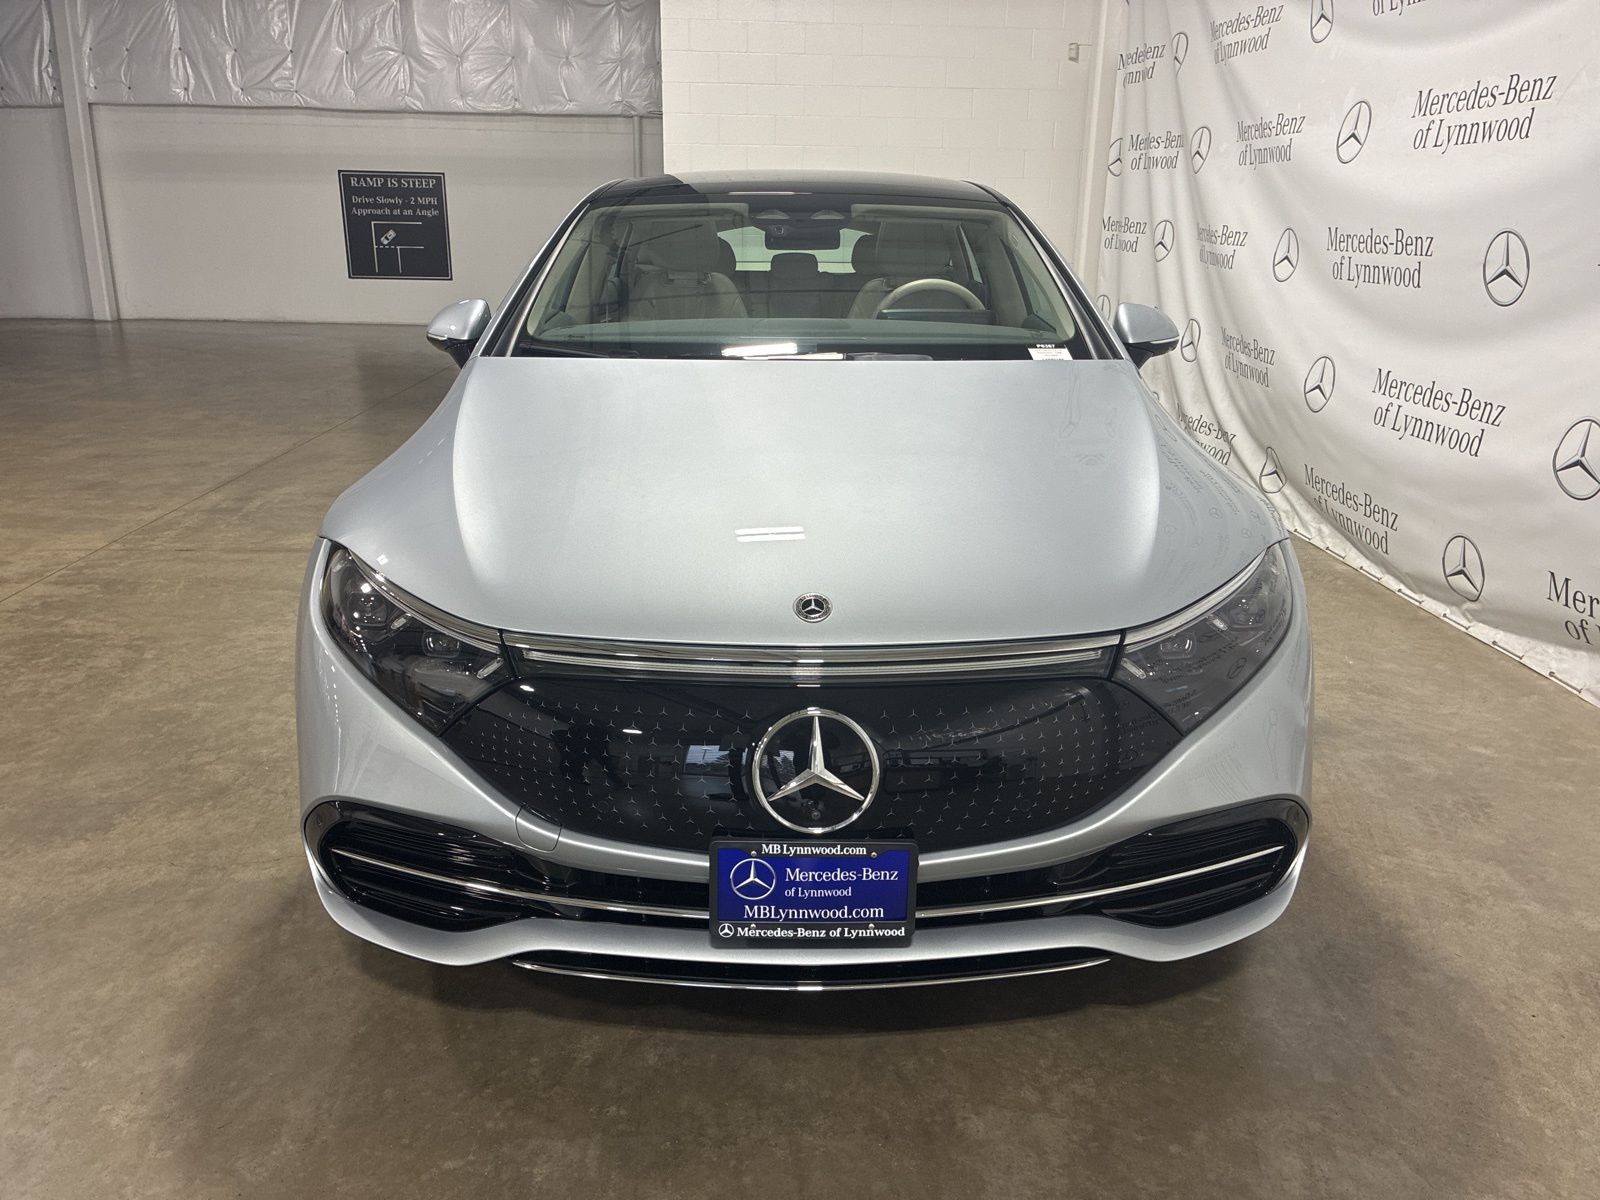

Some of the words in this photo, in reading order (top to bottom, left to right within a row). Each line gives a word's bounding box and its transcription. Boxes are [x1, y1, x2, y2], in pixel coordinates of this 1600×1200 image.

[1219, 26, 1271, 66] Lynnwood
[1411, 73, 1557, 118] Mercedes-Benz
[1236, 113, 1306, 143] Mercedes-Benz
[1413, 119, 1434, 150] of
[1433, 107, 1535, 155] Lynnwood
[1131, 152, 1143, 170] of
[1238, 143, 1249, 167] of
[1249, 138, 1293, 170] Lynnwood
[350, 177, 384, 187] RAMP
[387, 178, 398, 188] IS
[401, 178, 436, 189] STEEP
[351, 195, 374, 204] Drive
[376, 196, 402, 206] Slowly
[410, 197, 415, 205] 2
[417, 197, 438, 205] MPH
[351, 207, 391, 216] Approach
[415, 208, 440, 217] Angle
[1104, 233, 1115, 250] of
[1326, 226, 1434, 257] Mercedes-Benz
[1332, 255, 1345, 281] of
[1347, 257, 1422, 289] Lynnwood
[1231, 352, 1269, 388] Lynnwood
[1371, 367, 1507, 427] Mercedes-Benz
[1373, 402, 1393, 428] of
[1391, 404, 1485, 458] Lynnwood
[1304, 463, 1399, 532] Mercedes-Benz
[1564, 618, 1593, 646] of
[782, 844, 867, 857] Lynnwood.com
[785, 868, 899, 882] Mercedes-Benz
[784, 887, 795, 897] of
[798, 887, 852, 900] Lynnwood
[744, 905, 884, 922] MBLynnwood.com
[737, 926, 826, 938] Mercedes-Benz
[829, 927, 842, 937] of
[844, 926, 905, 939] Lynnwood
